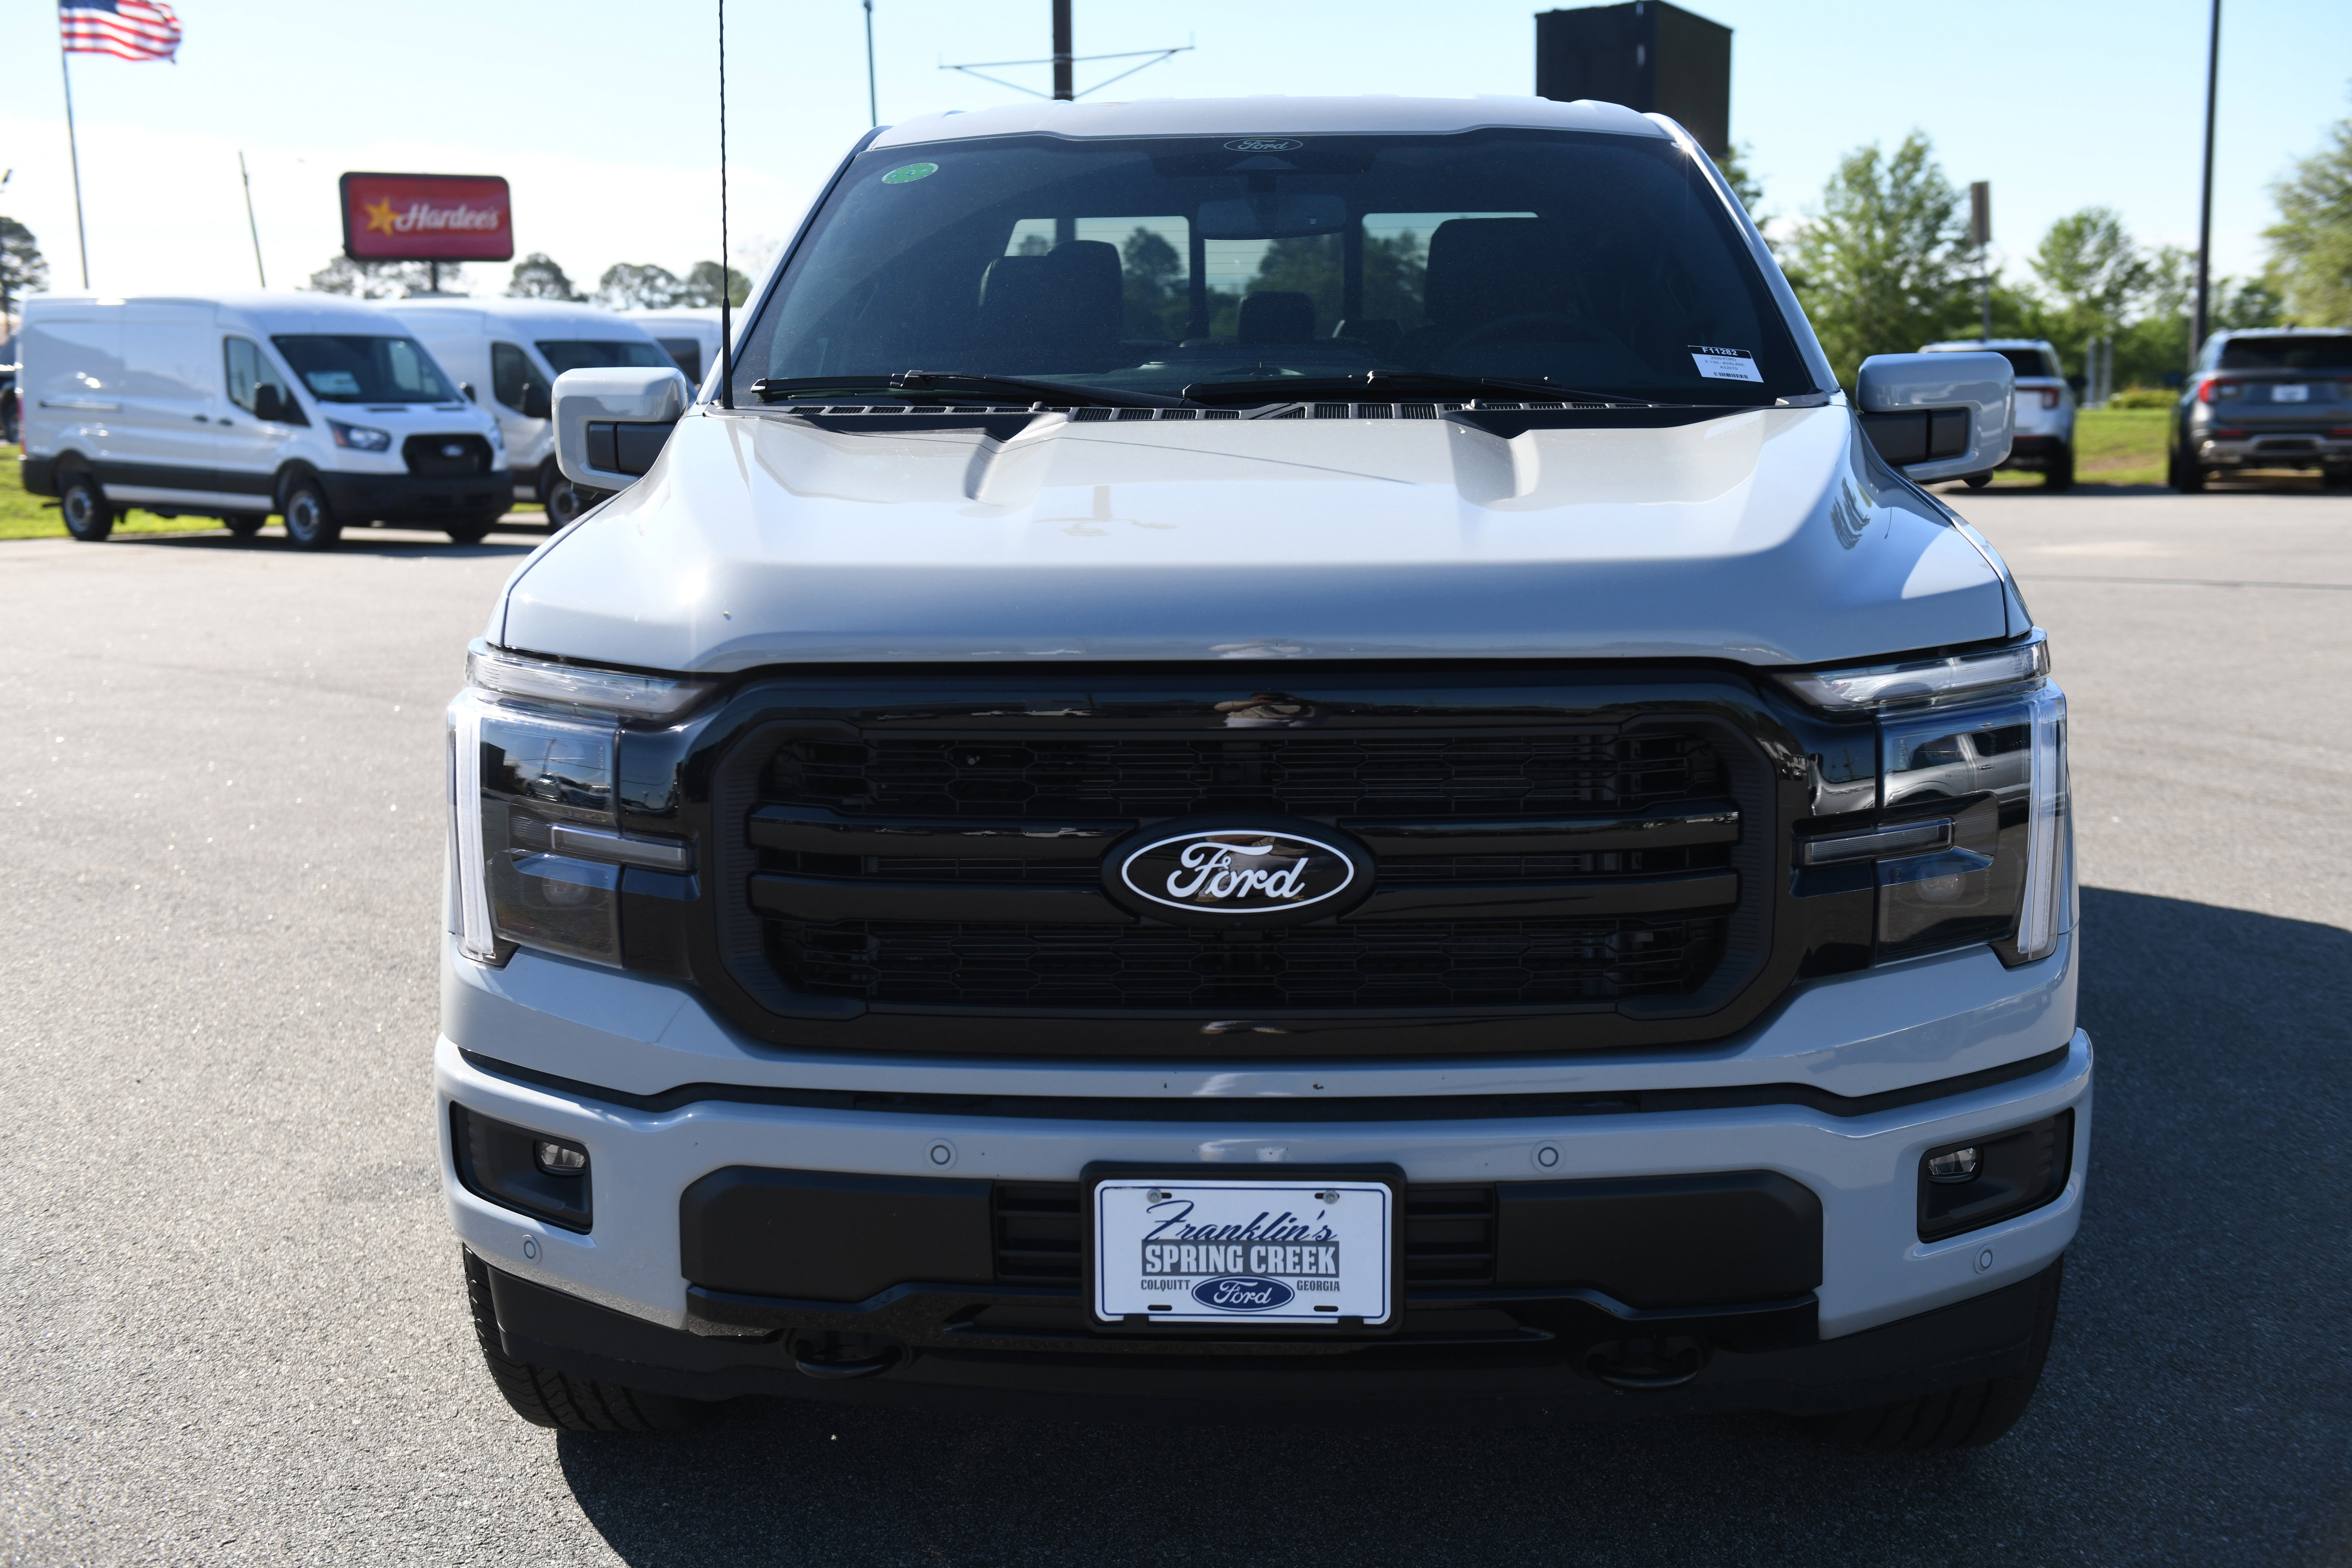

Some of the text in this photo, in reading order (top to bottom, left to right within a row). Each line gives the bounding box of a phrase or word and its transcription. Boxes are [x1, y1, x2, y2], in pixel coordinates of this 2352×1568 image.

[1238, 139, 1290, 149] Ford
[394, 203, 499, 232] Hardee's
[1702, 347, 1738, 356] F11282
[1167, 842, 1309, 898] Ford
[1144, 1200, 1337, 1242] Franklin's
[1145, 1244, 1337, 1275] SPRING CREEK
[1140, 1280, 1191, 1291] COLQUITT
[1213, 1280, 1272, 1305] Ford
[1296, 1281, 1340, 1292] GEORGIA
